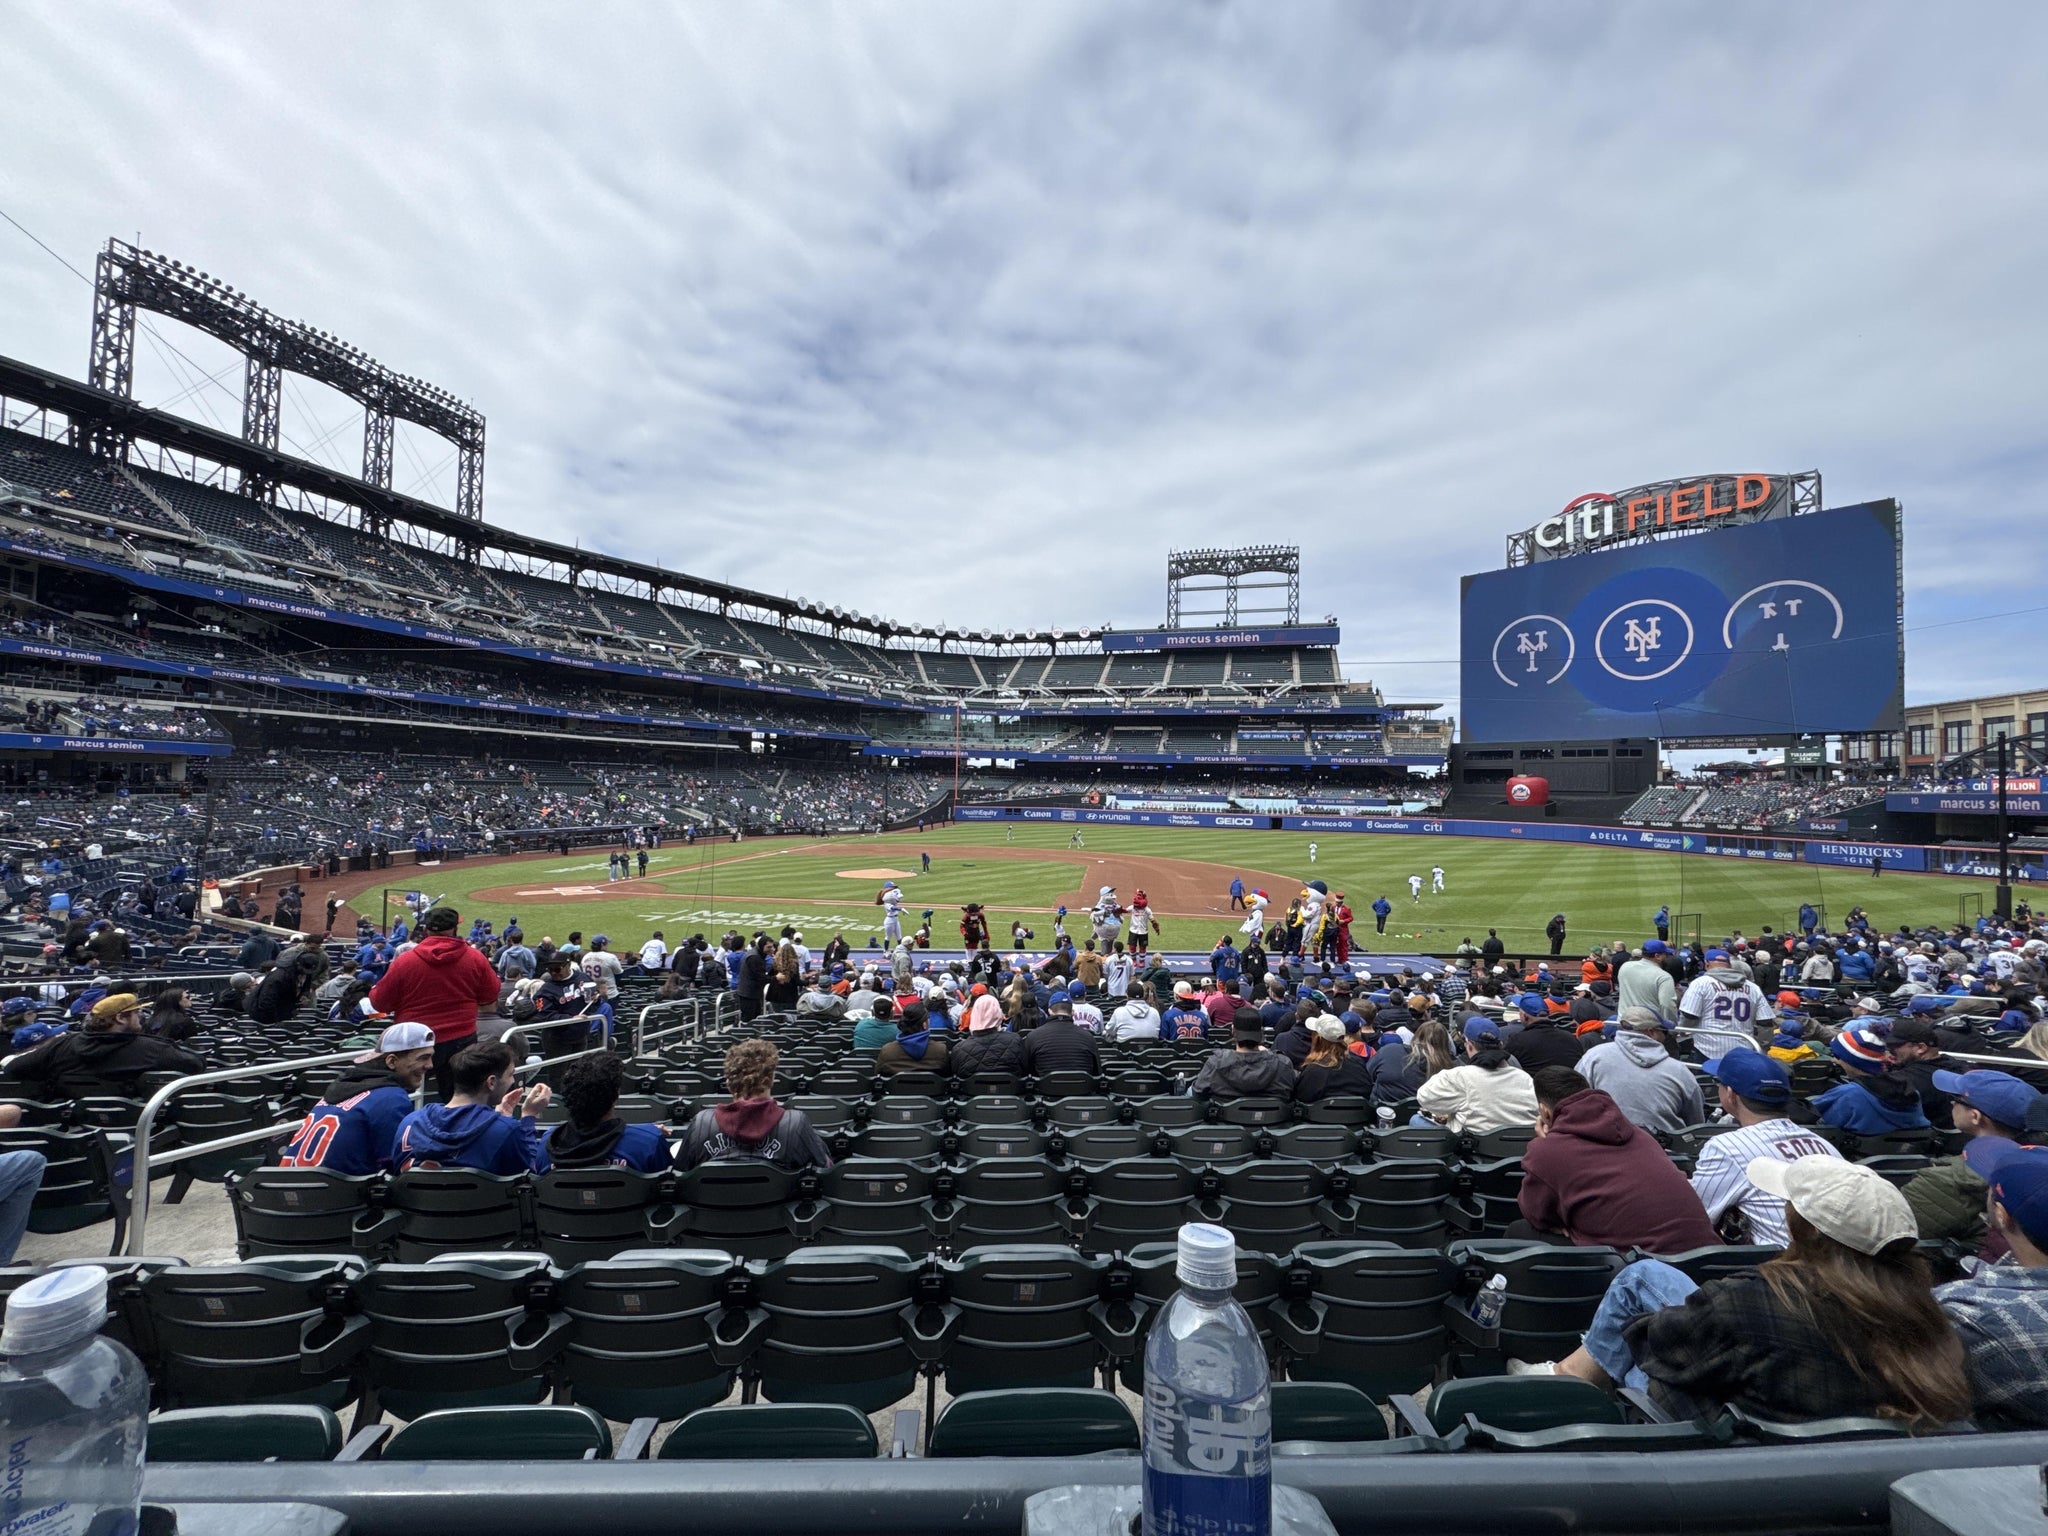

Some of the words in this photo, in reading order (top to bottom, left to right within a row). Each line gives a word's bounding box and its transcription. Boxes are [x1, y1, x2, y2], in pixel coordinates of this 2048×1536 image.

[1535, 493, 1616, 547] citi
[1626, 474, 1770, 531] FIELD
[12, 544, 38, 555] marcus
[40, 551, 66, 560] semien
[248, 598, 287, 610] marcus
[290, 607, 326, 618] semien
[426, 631, 453, 641] marcus
[455, 638, 480, 646] semien
[1167, 635, 1211, 644] marcus
[1215, 633, 1259, 643] semien
[23, 645, 62, 657] marcus
[65, 651, 102, 661] semien
[551, 655, 571, 663] marcus
[212, 670, 245, 679] marcus
[248, 673, 280, 683] semien
[366, 687, 389, 696] marcus
[108, 742, 144, 750] semien
[1972, 782, 1988, 791] citi
[1993, 782, 2036, 791] PVILION
[1940, 800, 1985, 809] marcus
[962, 809, 998, 817] HealthEquity
[1215, 817, 1253, 826] GEICO
[1424, 822, 1442, 832] citi
[1598, 832, 1628, 841] DELTA
[1821, 845, 1903, 858] HENDRICK'S
[692, 910, 859, 922] NewYork-
[981, 963, 992, 973] 15
[1225, 959, 1236, 968] 43
[585, 965, 602, 978] 69
[1117, 967, 1124, 980] 7
[1926, 966, 1939, 975] 50
[1714, 996, 1750, 1022] 20
[1173, 1014, 1202, 1024] ALONSO
